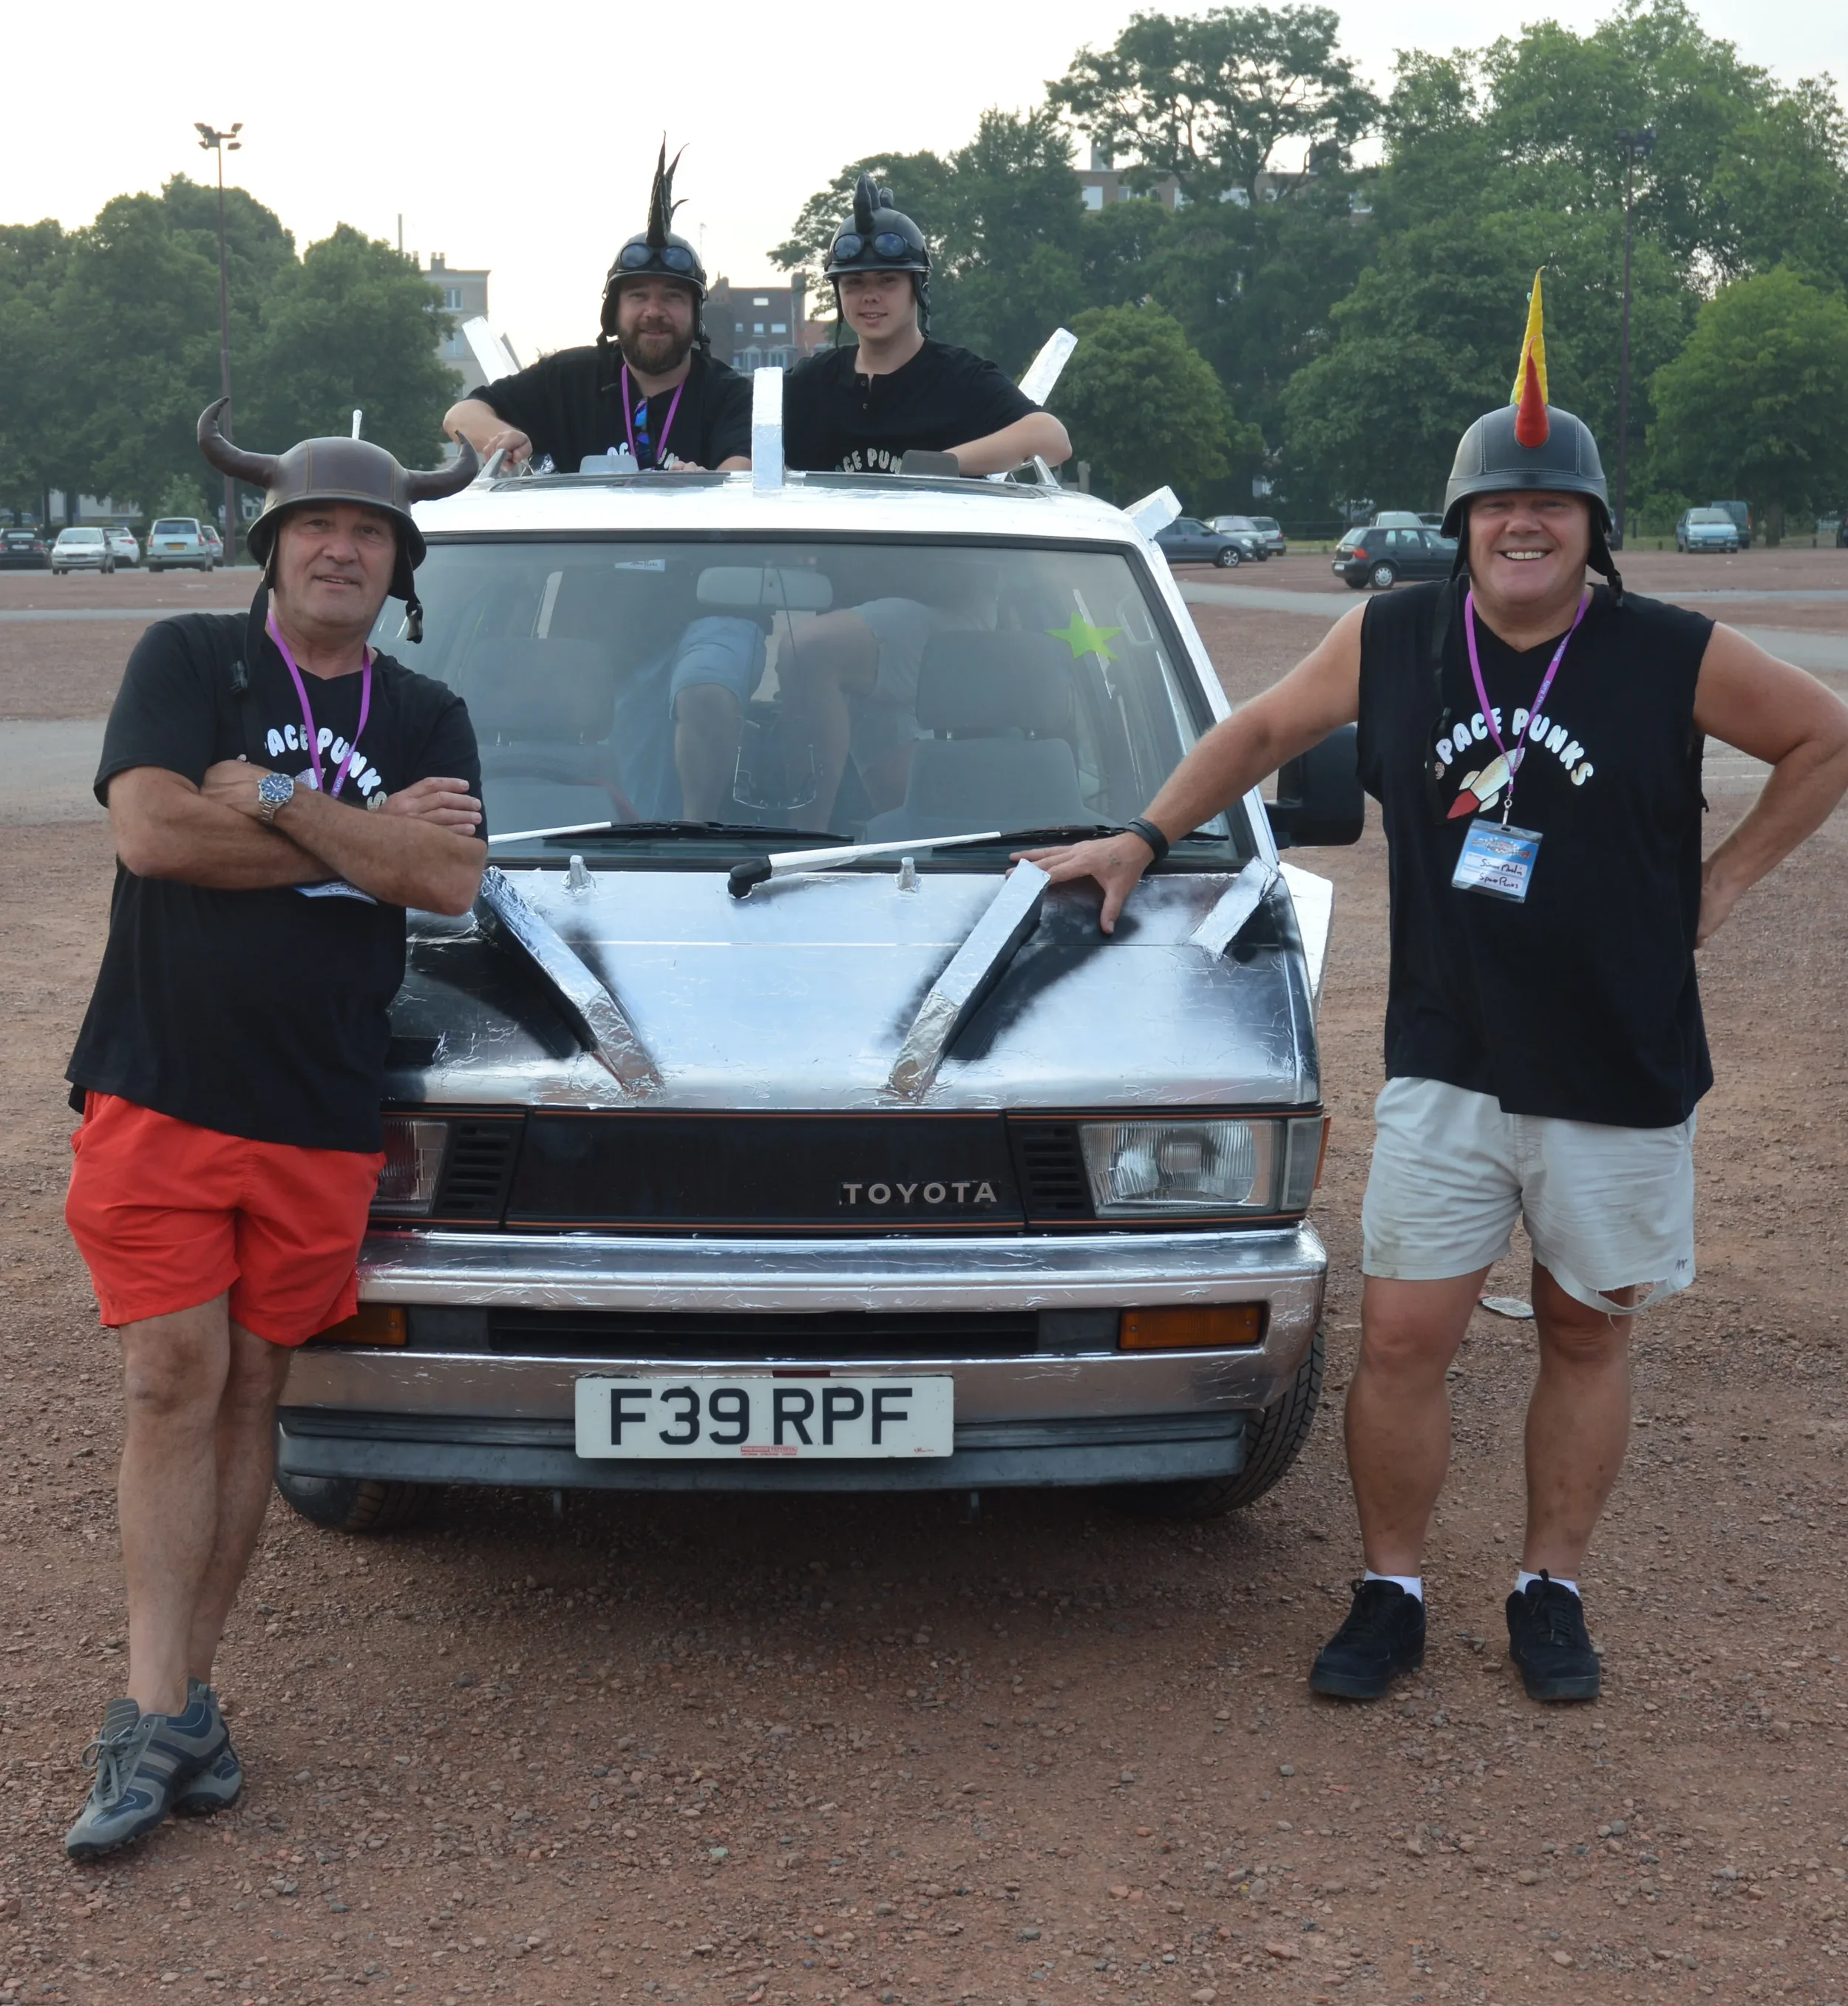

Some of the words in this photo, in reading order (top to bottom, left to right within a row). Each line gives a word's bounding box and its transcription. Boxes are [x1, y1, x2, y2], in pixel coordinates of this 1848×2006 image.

[264, 724, 309, 757] ACE
[1512, 707, 1594, 786] PUNKS
[843, 1182, 997, 1204] TOYOTA
[611, 1387, 750, 1446] F39
[773, 1387, 913, 1446] RPF
